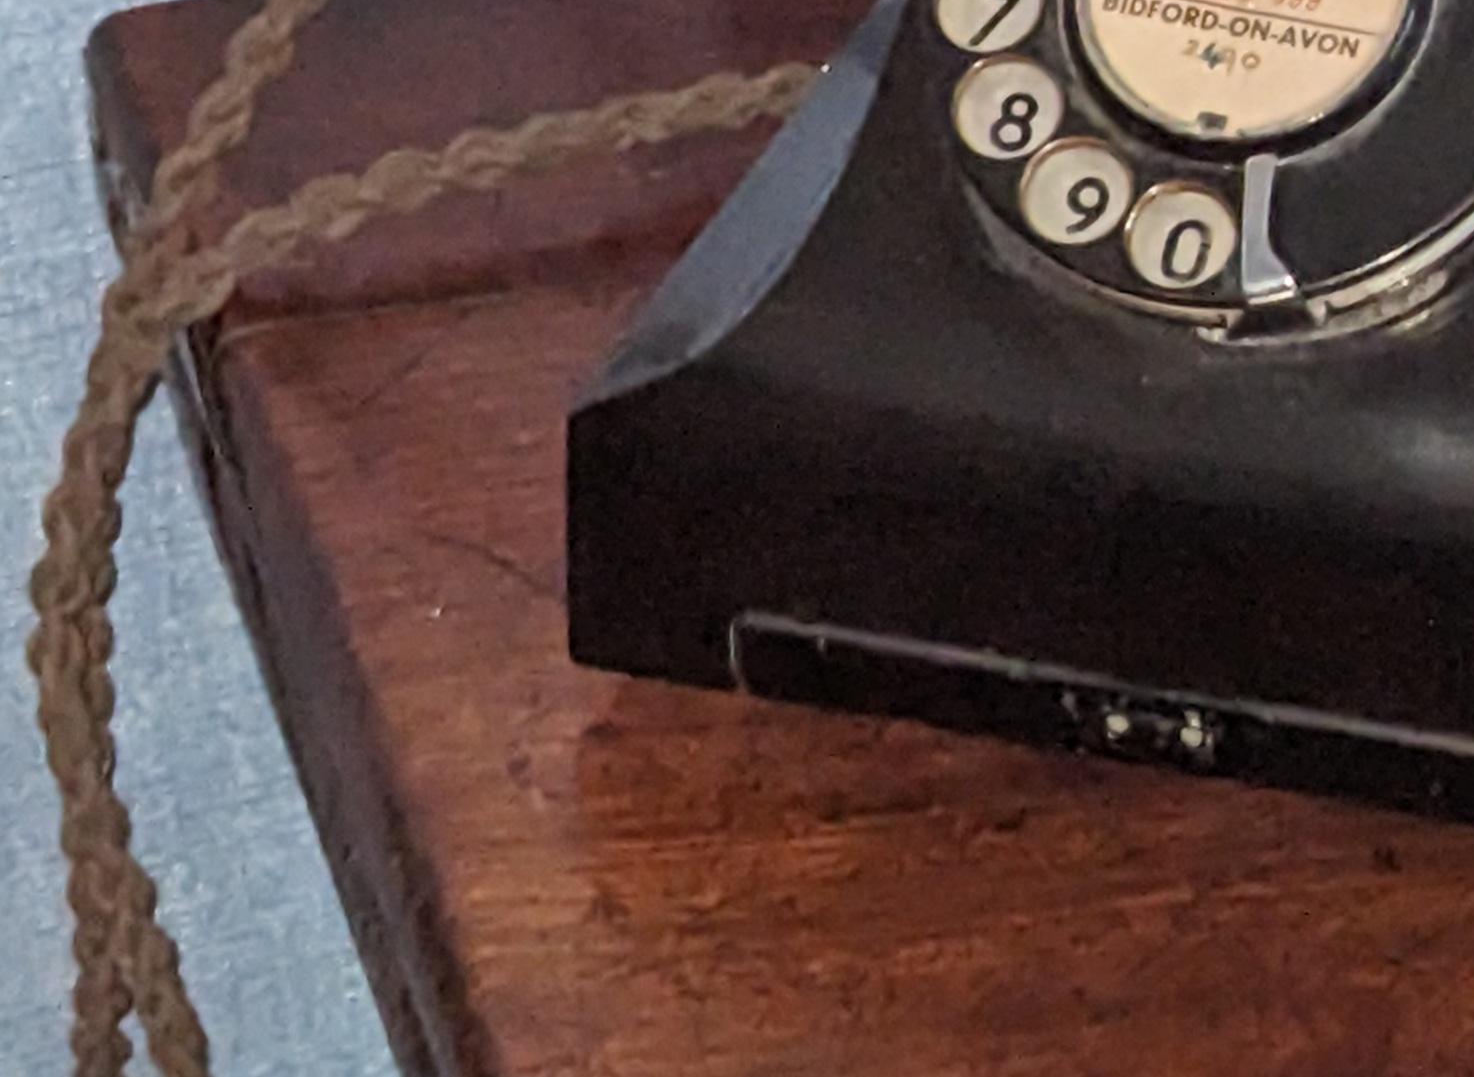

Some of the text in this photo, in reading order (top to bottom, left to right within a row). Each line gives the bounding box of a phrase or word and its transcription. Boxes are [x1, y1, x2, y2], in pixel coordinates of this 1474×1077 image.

[990, 92, 1038, 151] 8
[1066, 177, 1110, 234] 9
[1161, 219, 1211, 281] 0
